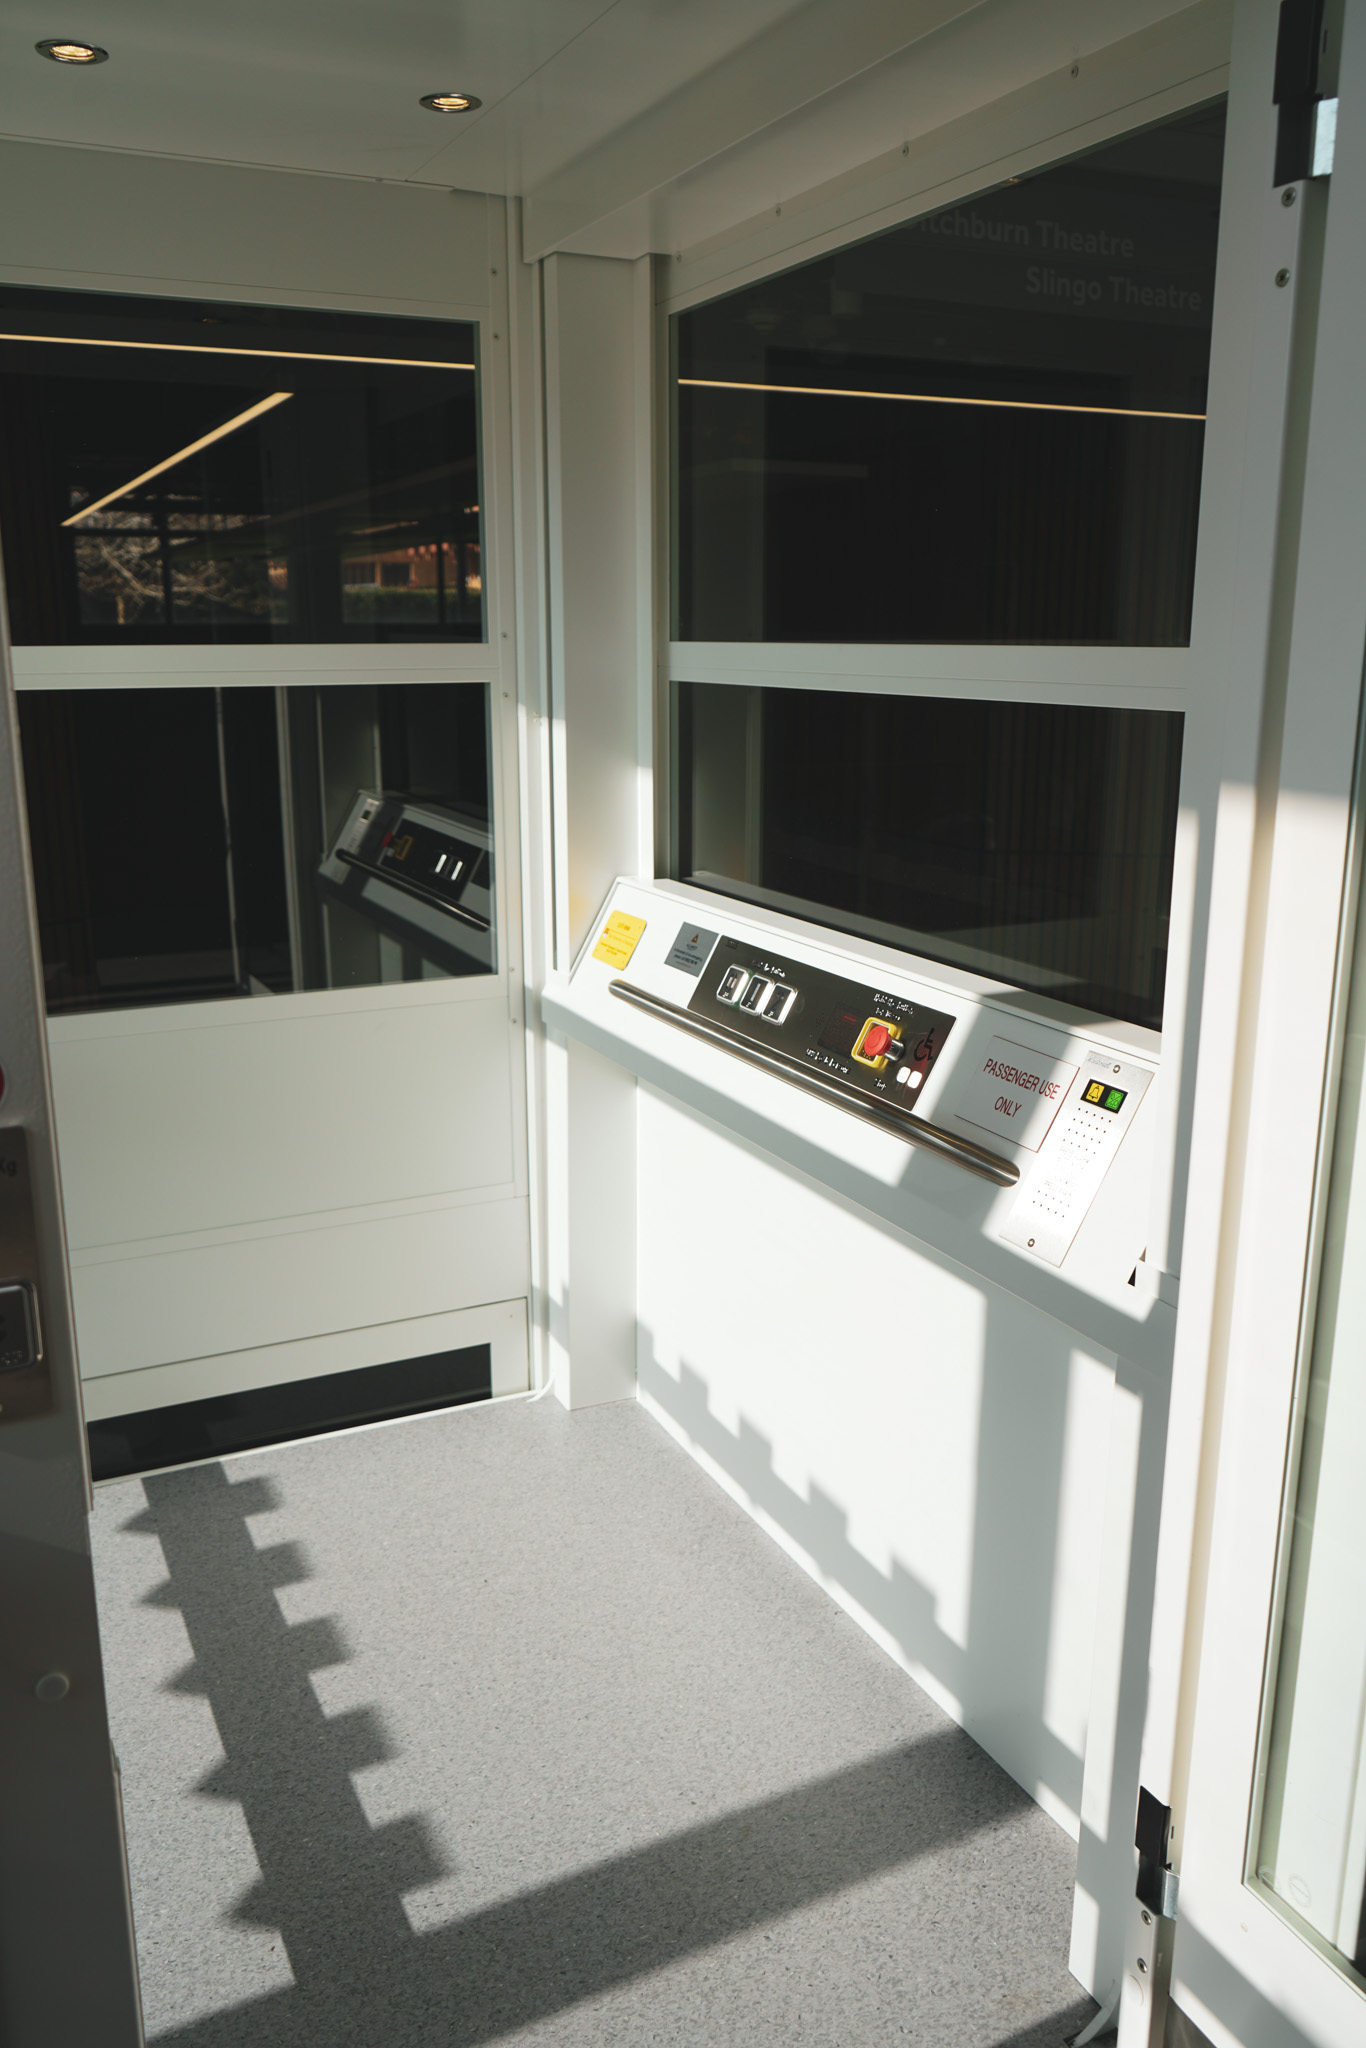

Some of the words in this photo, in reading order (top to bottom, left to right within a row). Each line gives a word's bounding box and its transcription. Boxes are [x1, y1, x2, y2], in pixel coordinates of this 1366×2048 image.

[1035, 219, 1134, 258] Theatre
[1025, 266, 1102, 306] Slingo
[1108, 274, 1201, 311] Theatre
[983, 1058, 1040, 1092] PASSENGER
[1038, 1079, 1061, 1100] USE
[994, 1096, 1022, 1118] ONLY
